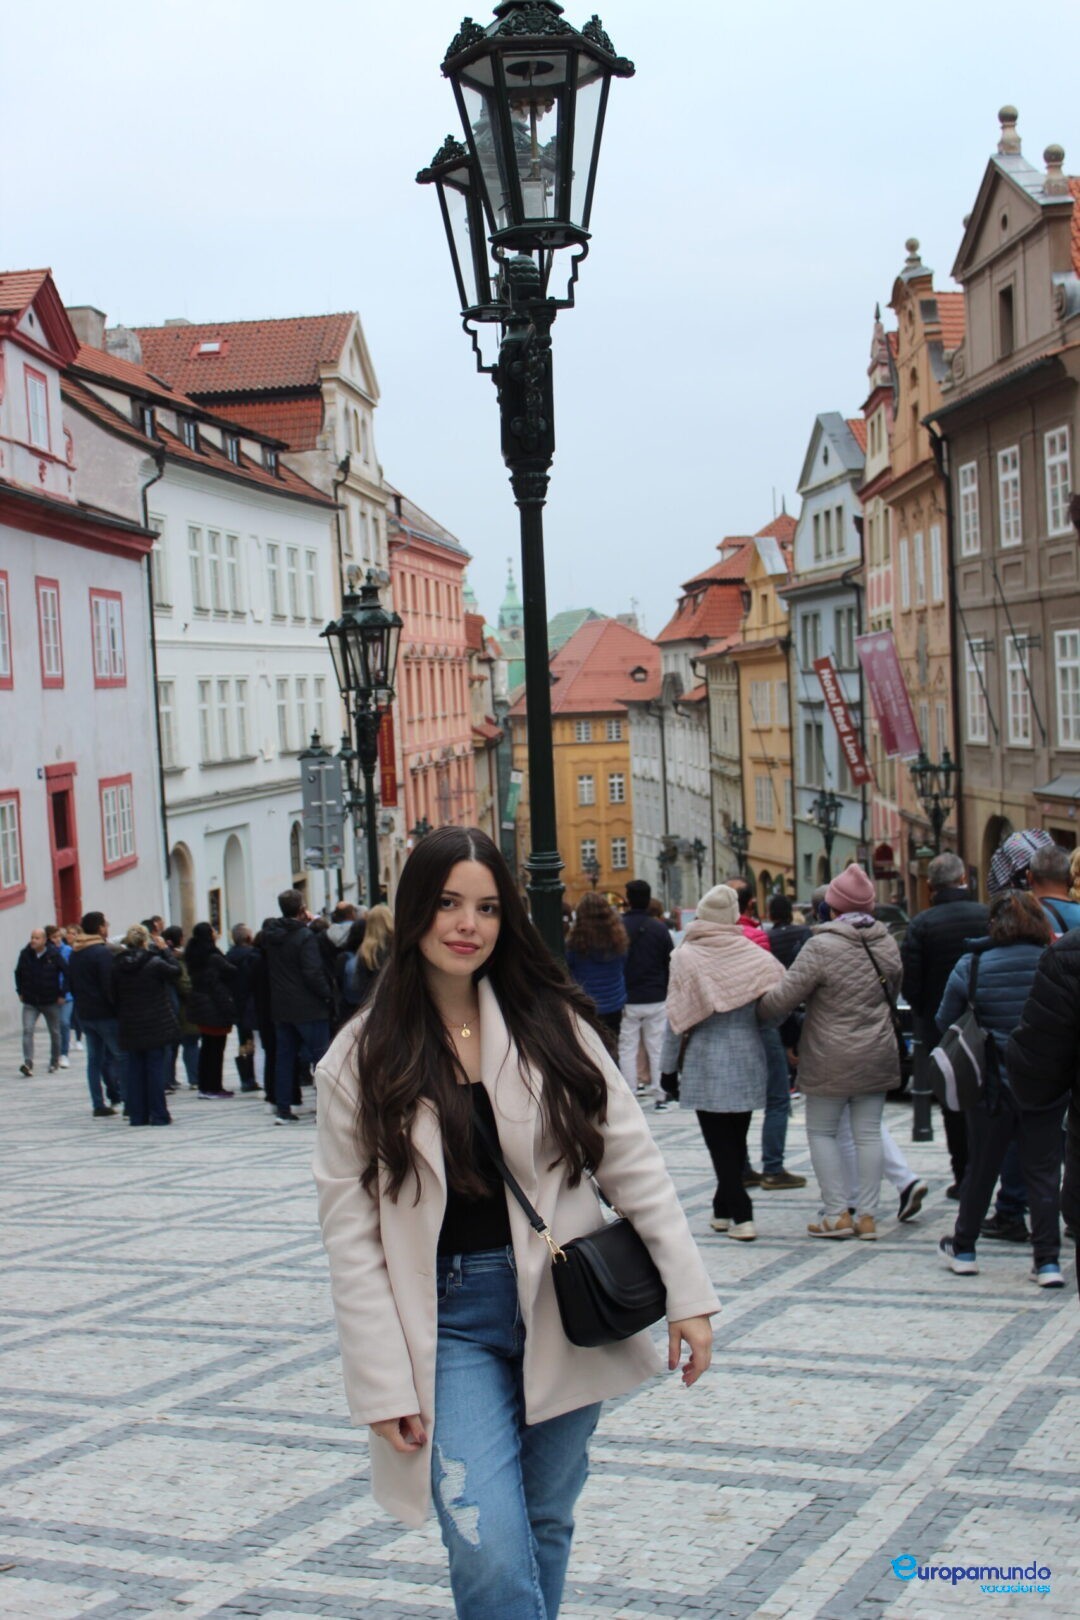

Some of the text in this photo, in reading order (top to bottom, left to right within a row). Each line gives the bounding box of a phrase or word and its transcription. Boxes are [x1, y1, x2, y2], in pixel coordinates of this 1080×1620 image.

[820, 669, 858, 764] Hotel Red Lion
